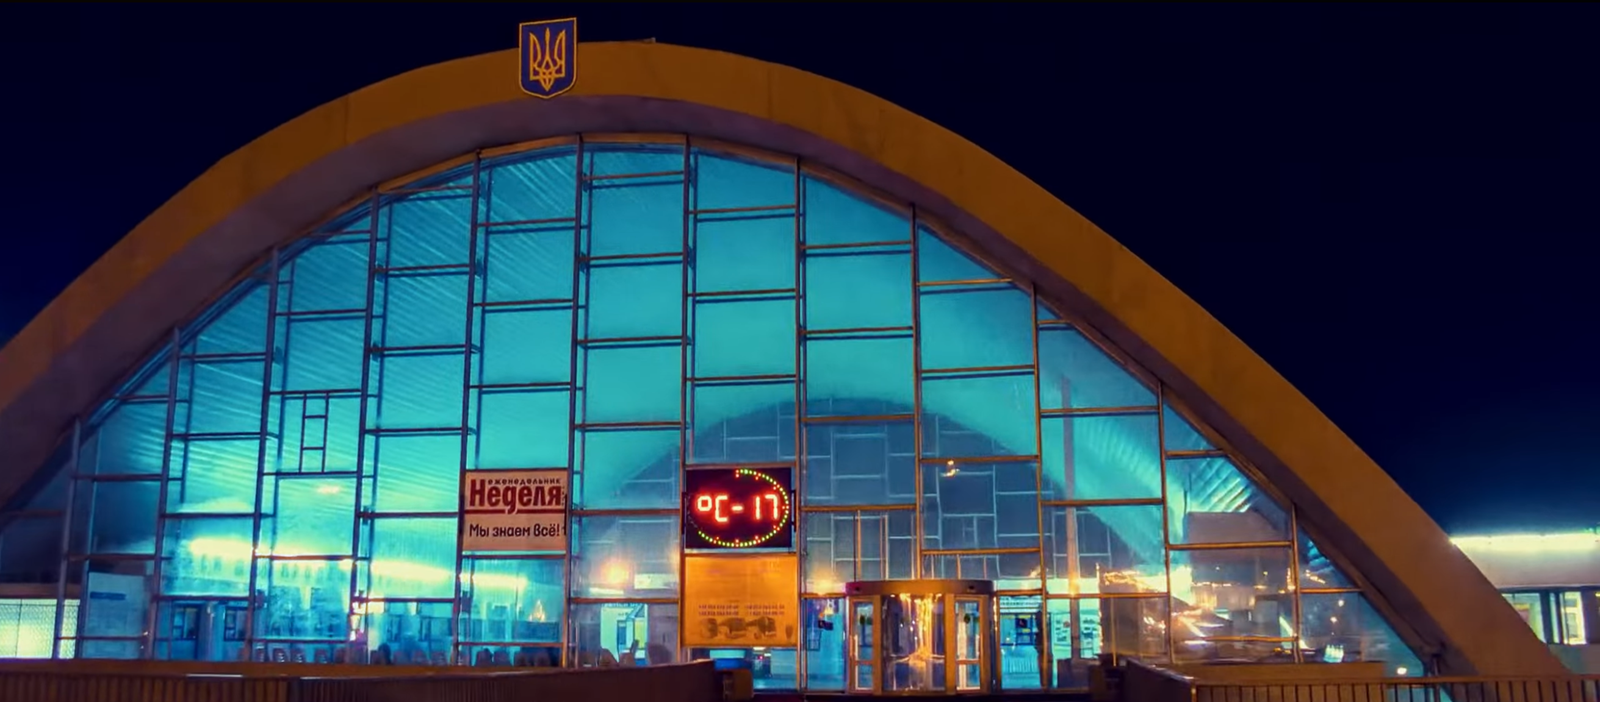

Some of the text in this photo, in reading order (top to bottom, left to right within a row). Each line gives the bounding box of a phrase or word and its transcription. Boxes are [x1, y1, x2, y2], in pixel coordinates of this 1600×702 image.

[469, 479, 561, 514] Неделя
[469, 523, 560, 537] Мы знаем всё!
